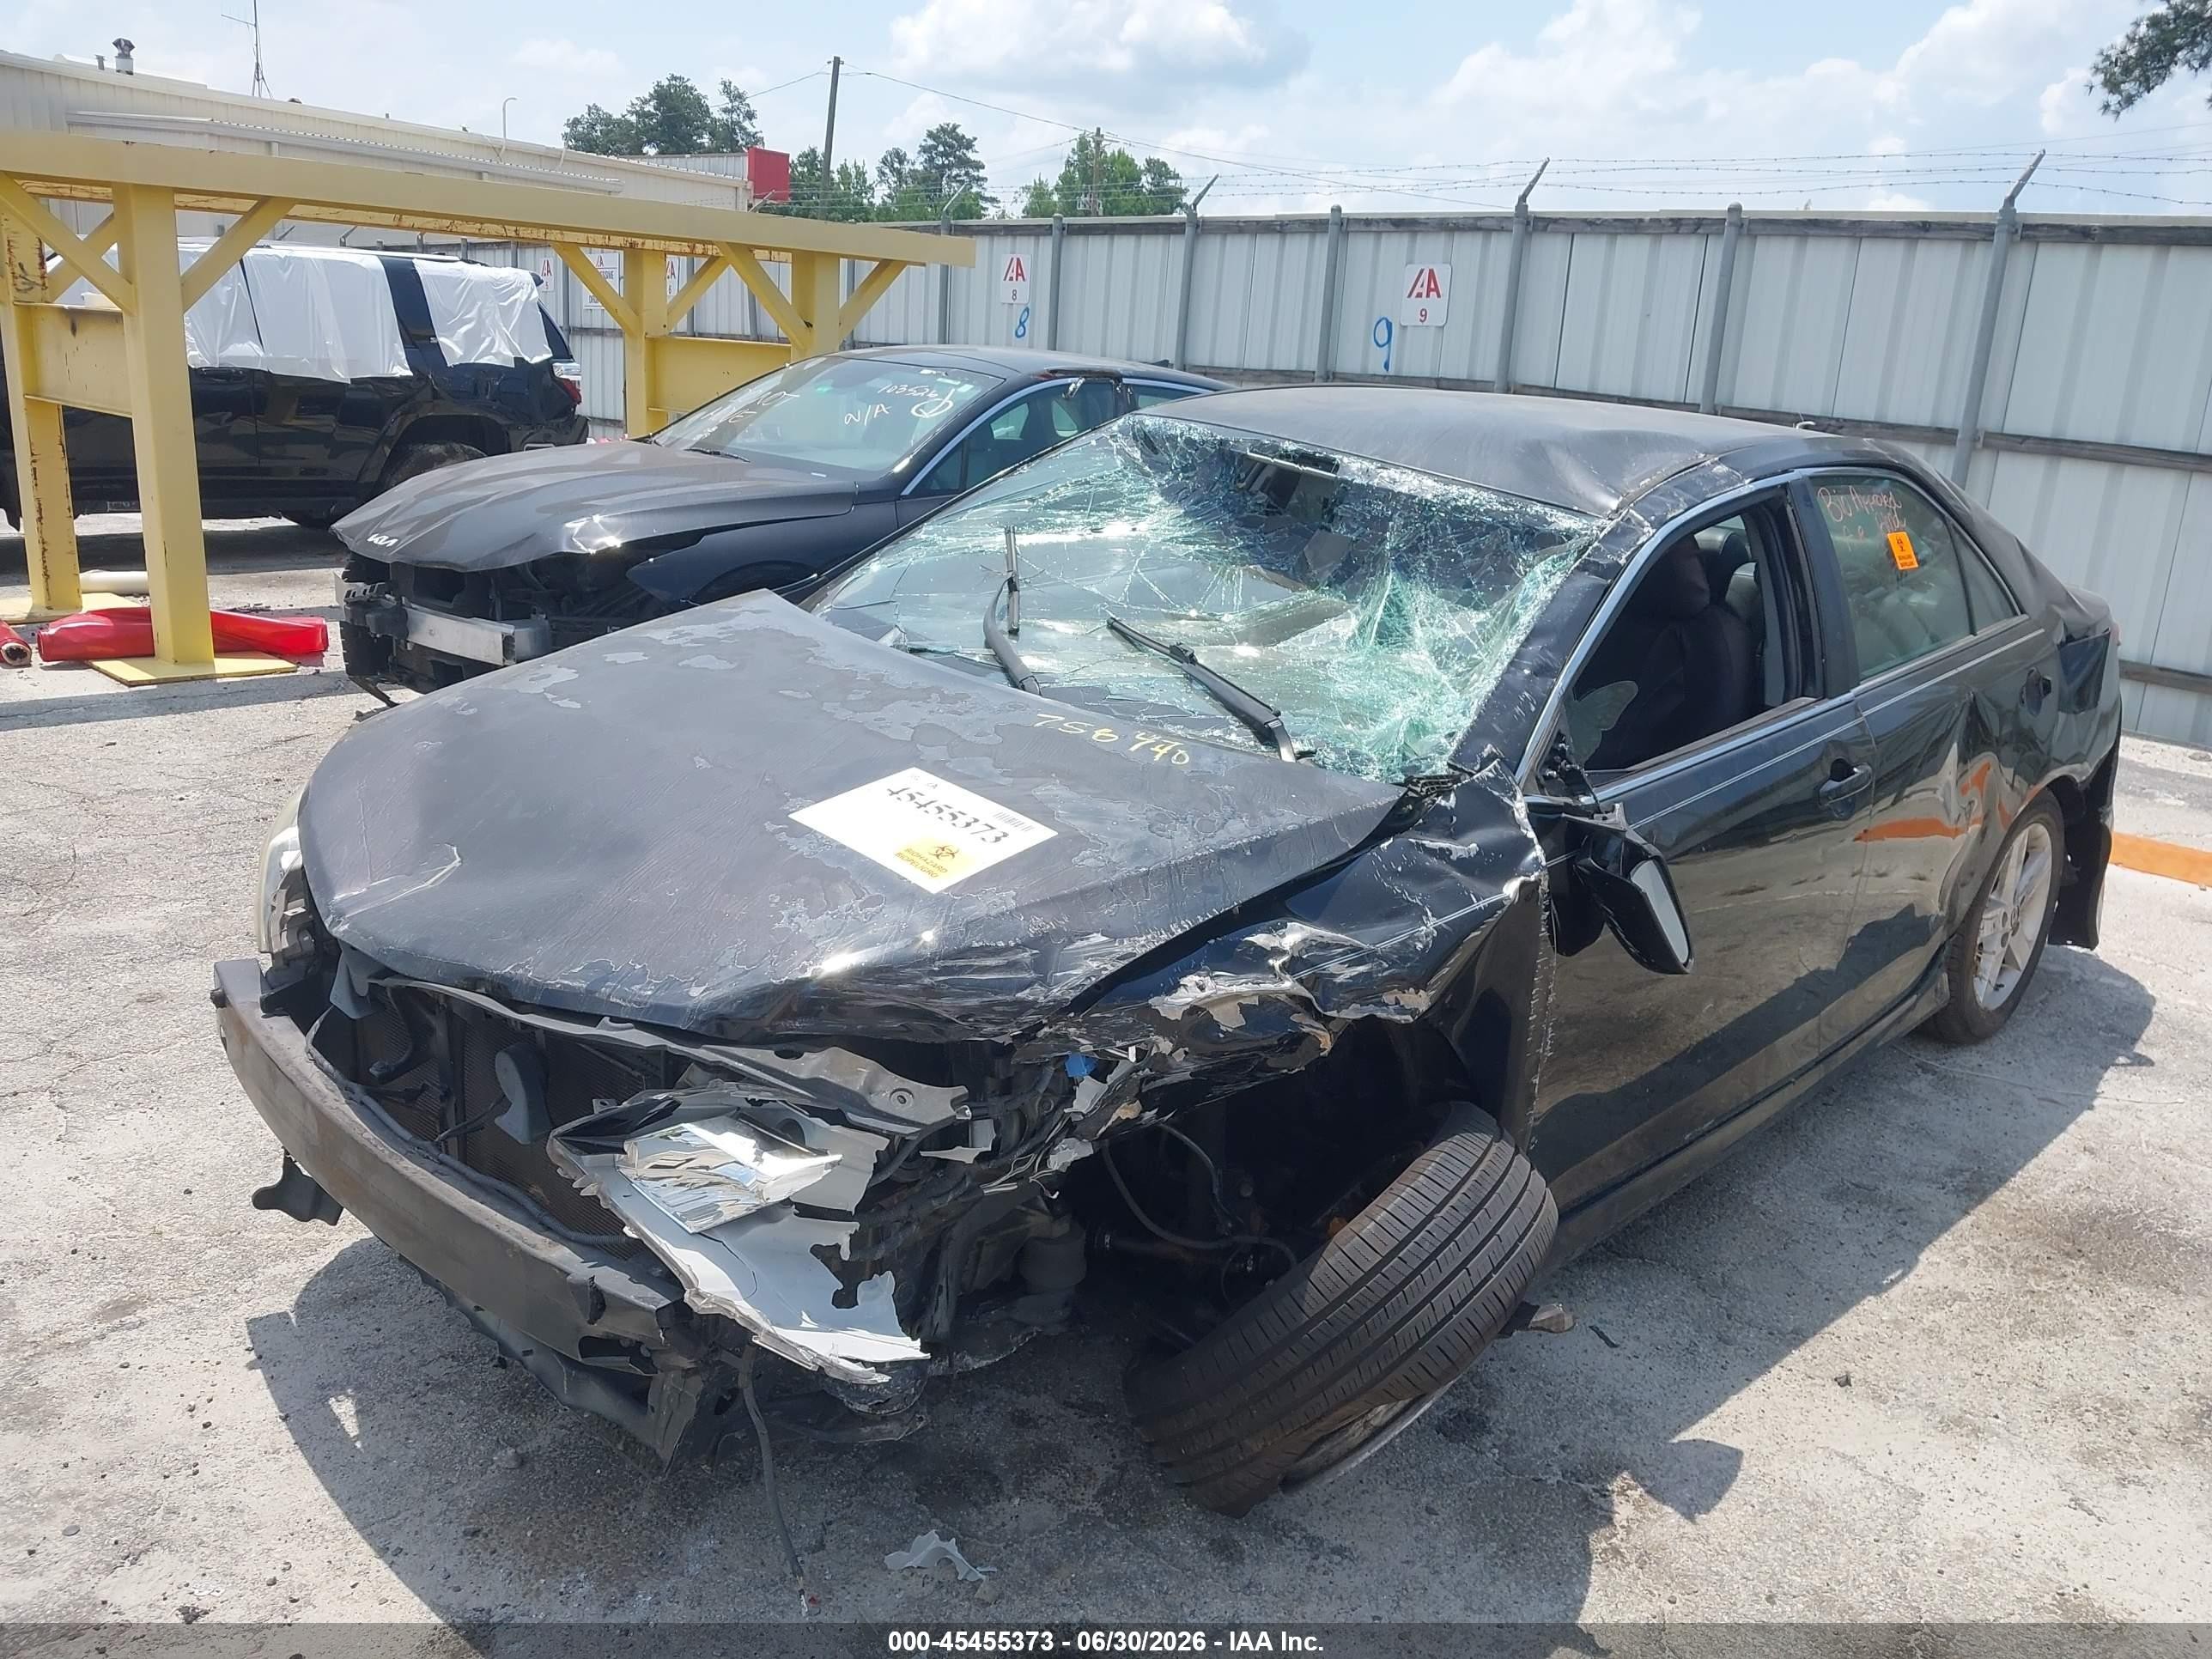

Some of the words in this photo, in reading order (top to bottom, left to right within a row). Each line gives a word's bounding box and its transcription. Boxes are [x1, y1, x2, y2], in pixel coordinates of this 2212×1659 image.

[1011, 289, 1018, 301] 8
[1014, 306, 1030, 339] 8
[1419, 307, 1428, 323] 9
[1373, 316, 1393, 373] 9
[887, 787, 1010, 843] 45455373
[894, 851, 939, 878] BIOPELIGRO
[905, 847, 949, 874] BIOHAZARD
